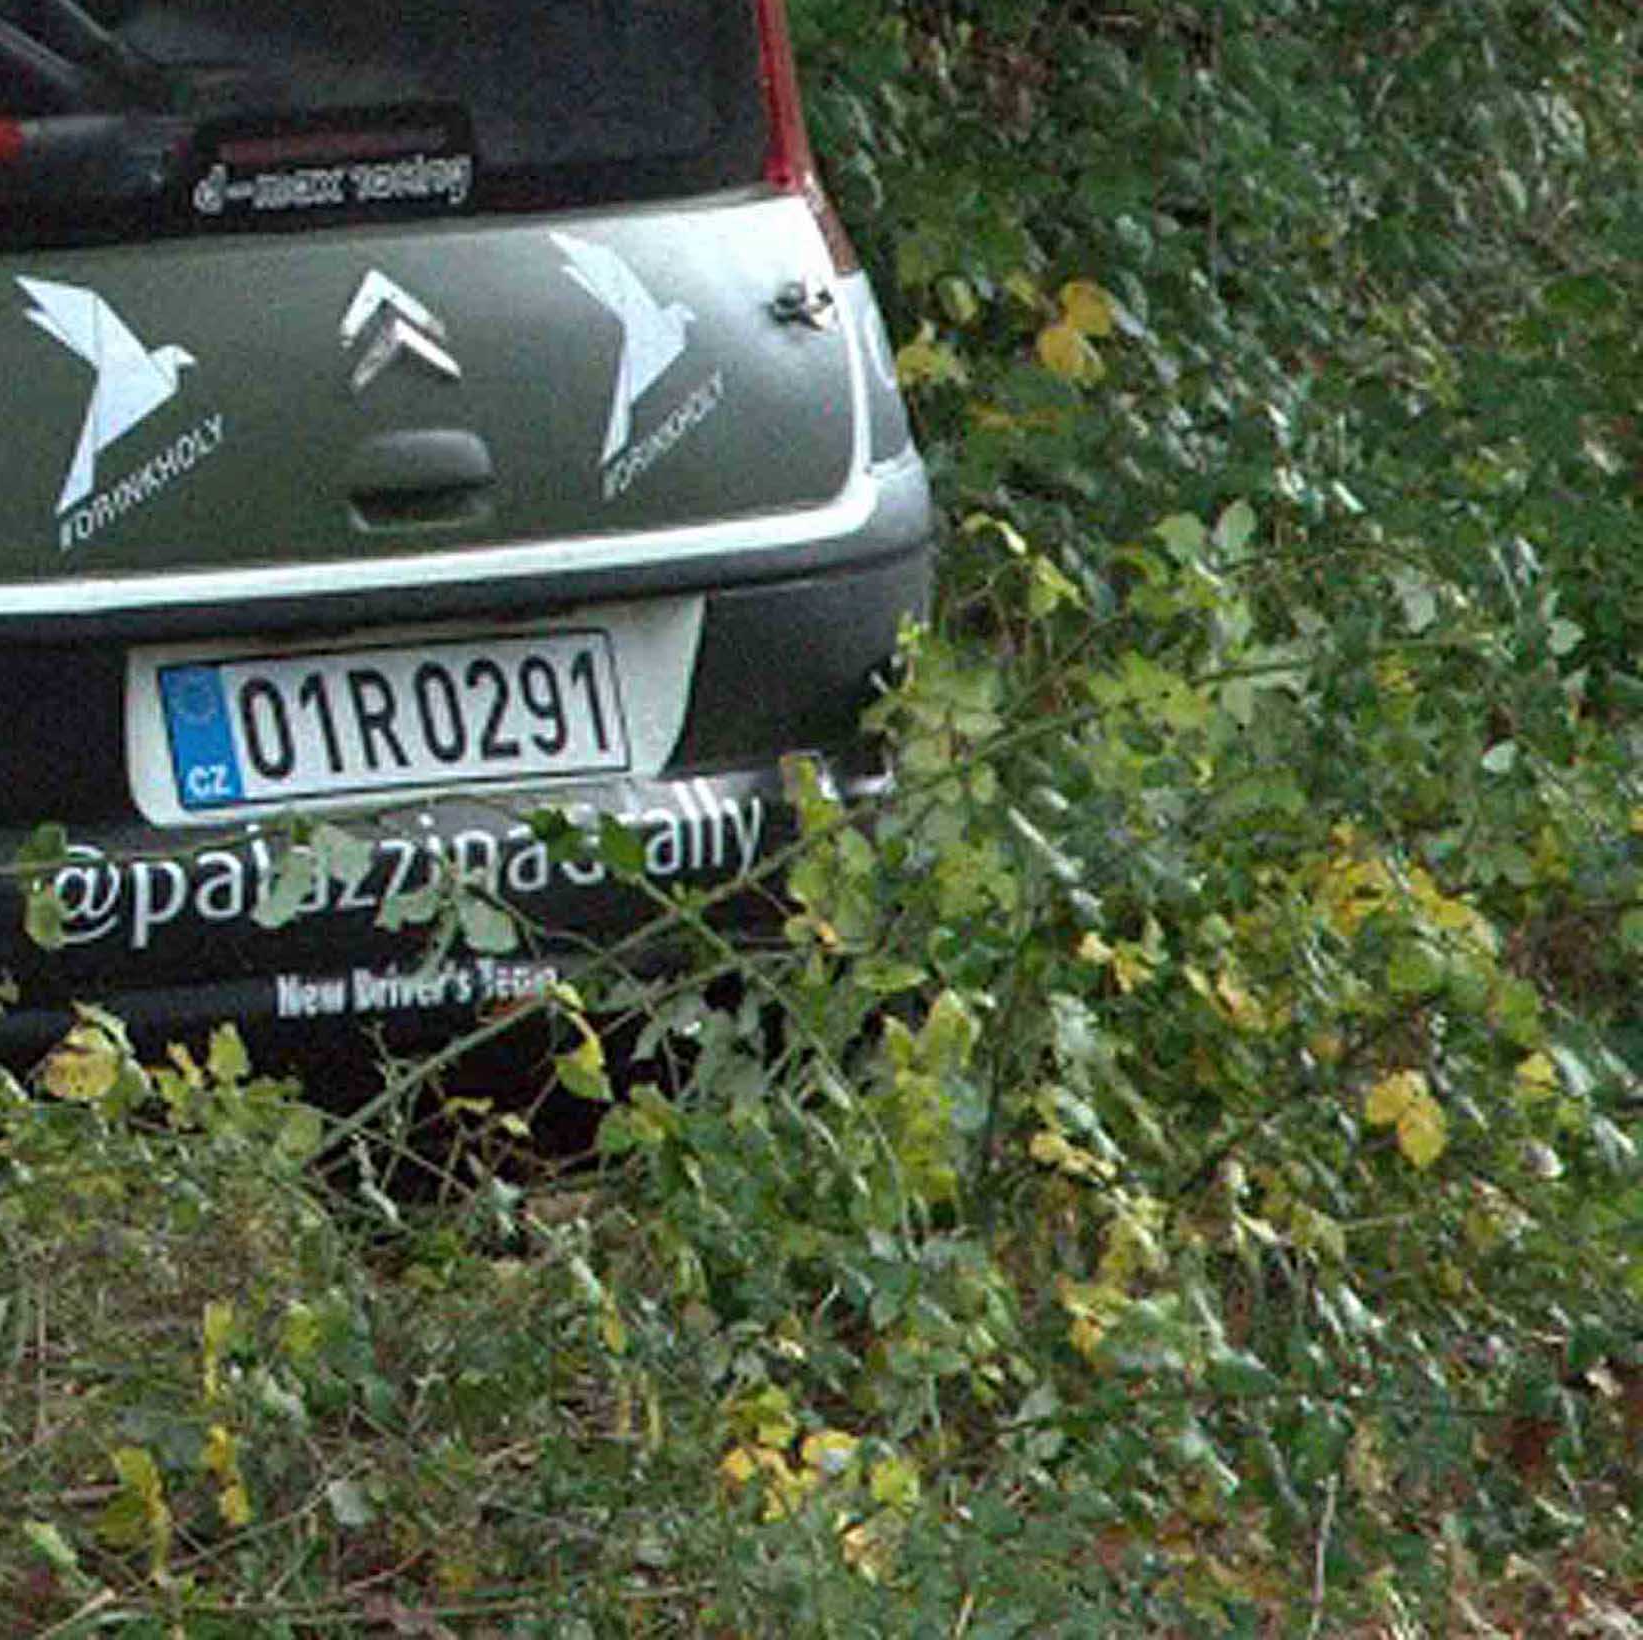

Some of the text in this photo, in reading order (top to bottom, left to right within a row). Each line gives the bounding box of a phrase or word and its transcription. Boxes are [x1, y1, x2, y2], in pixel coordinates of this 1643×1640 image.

[59, 413, 224, 552] #DRINKHOLY
[238, 649, 612, 780] 01R0291
[185, 764, 235, 797] CZ
[276, 972, 347, 1018] New
